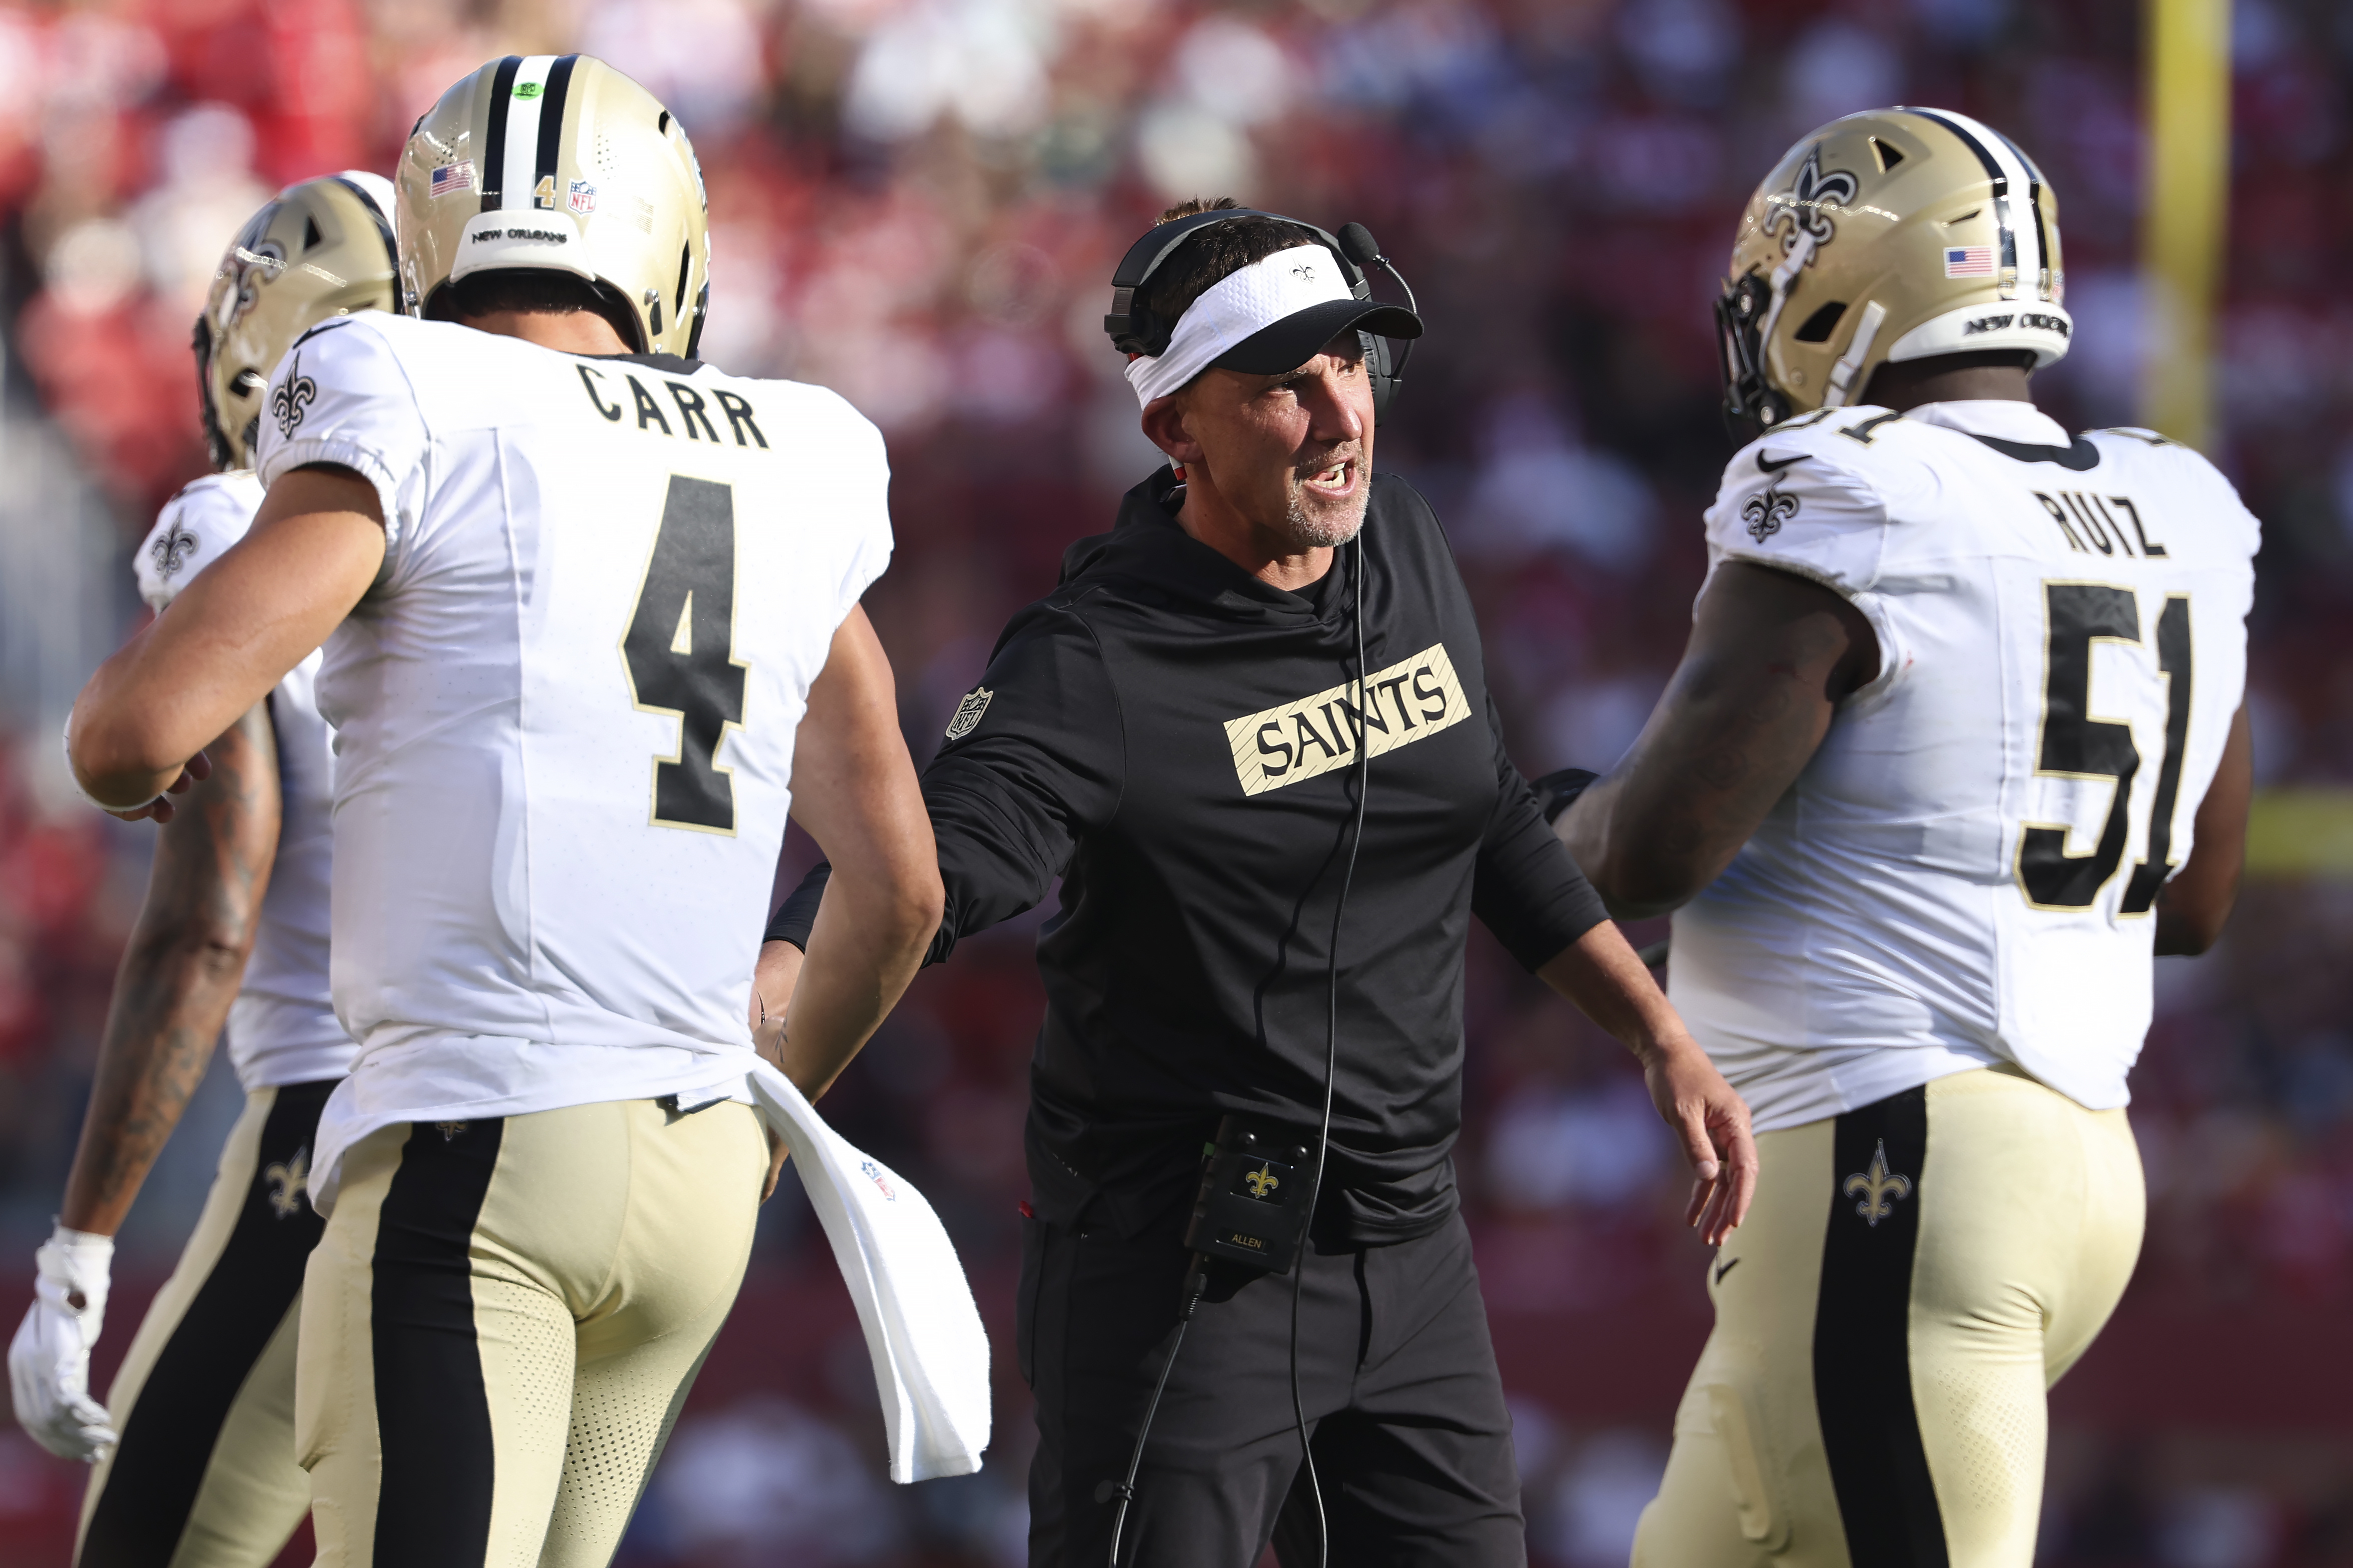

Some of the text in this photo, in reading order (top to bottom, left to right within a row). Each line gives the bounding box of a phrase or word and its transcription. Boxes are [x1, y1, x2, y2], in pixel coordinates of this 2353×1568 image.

[534, 175, 556, 207] 4
[570, 193, 595, 211] NFL
[472, 228, 567, 244] NEW ORLEANS
[1962, 313, 2014, 336] NEW
[575, 363, 772, 452] CARR
[2029, 489, 2170, 559] RUIZ
[617, 469, 751, 838] 4
[952, 711, 976, 731] NFL
[1256, 663, 1447, 780] SAINTS
[2012, 578, 2191, 919] 51
[1231, 1234, 1262, 1249] ALLEN
